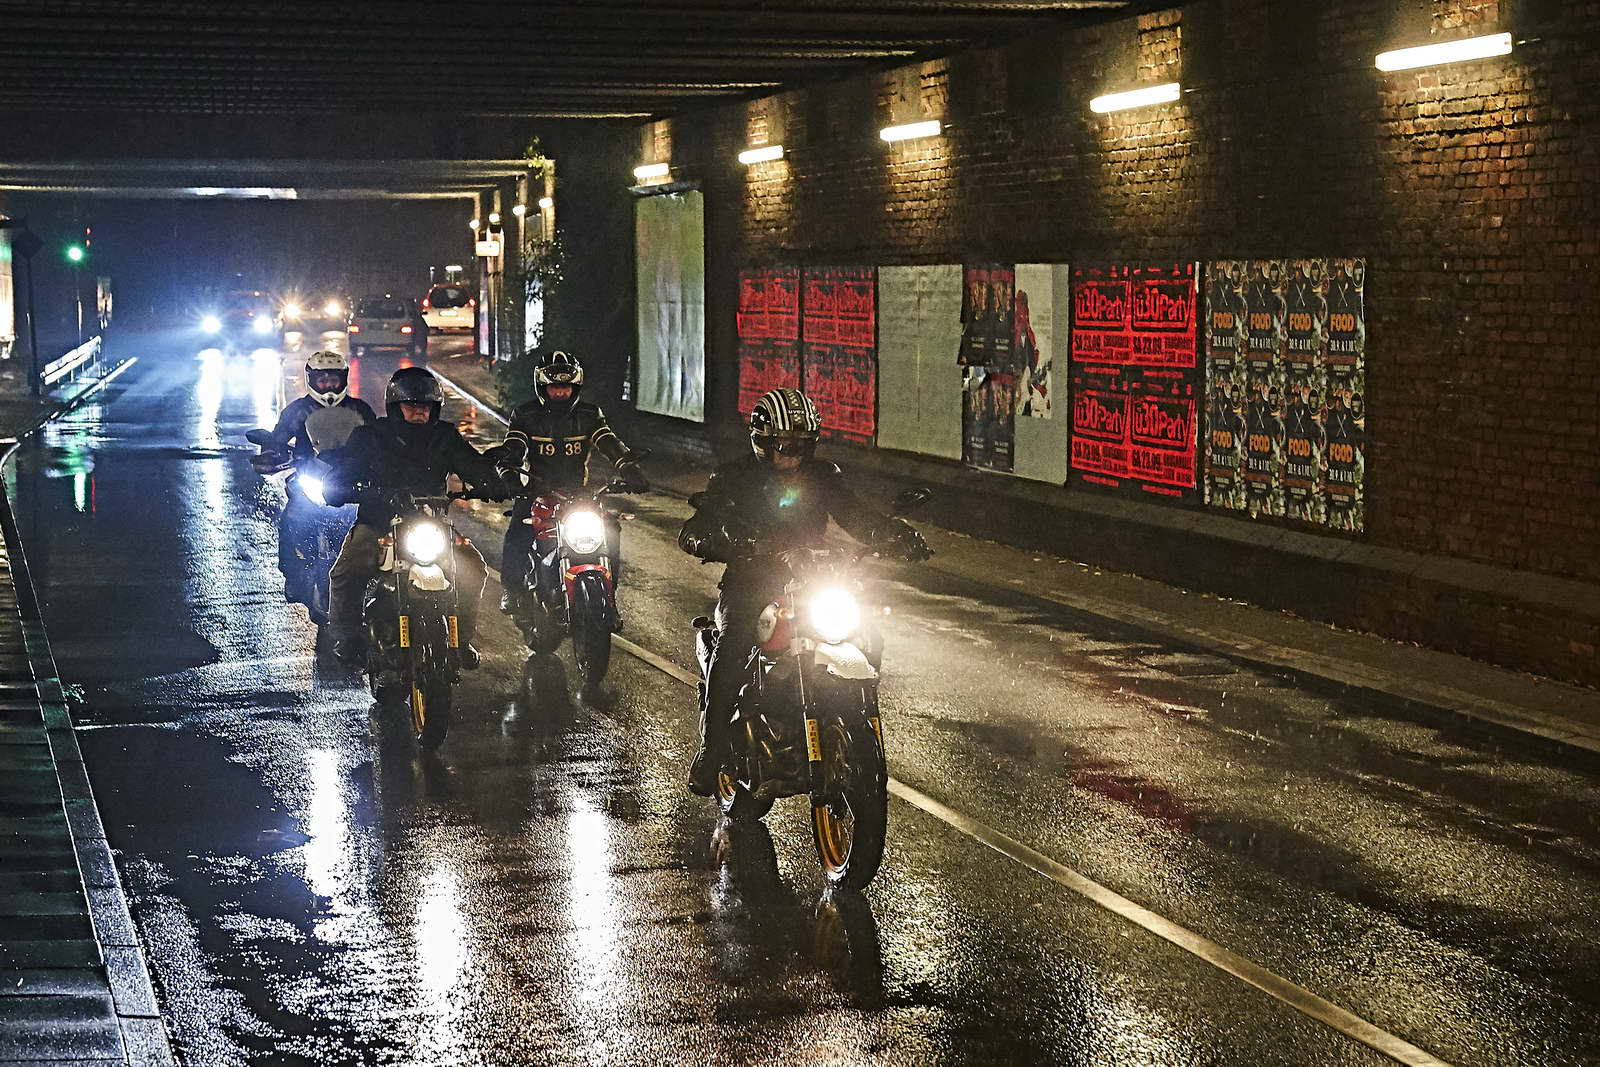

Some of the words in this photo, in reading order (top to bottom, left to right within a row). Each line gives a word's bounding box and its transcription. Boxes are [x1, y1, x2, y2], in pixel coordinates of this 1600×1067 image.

[1213, 312, 1233, 328] FOOD
[1250, 313, 1271, 330] FOOD
[1289, 313, 1312, 331] FOOD
[1330, 313, 1355, 331] FOOD
[1212, 431, 1232, 448] FOOD
[1249, 434, 1270, 453] FOOD
[1288, 438, 1311, 457] FOOD
[538, 443, 555, 456] 19
[565, 442, 582, 456] 38
[1329, 443, 1353, 462] FOOD
